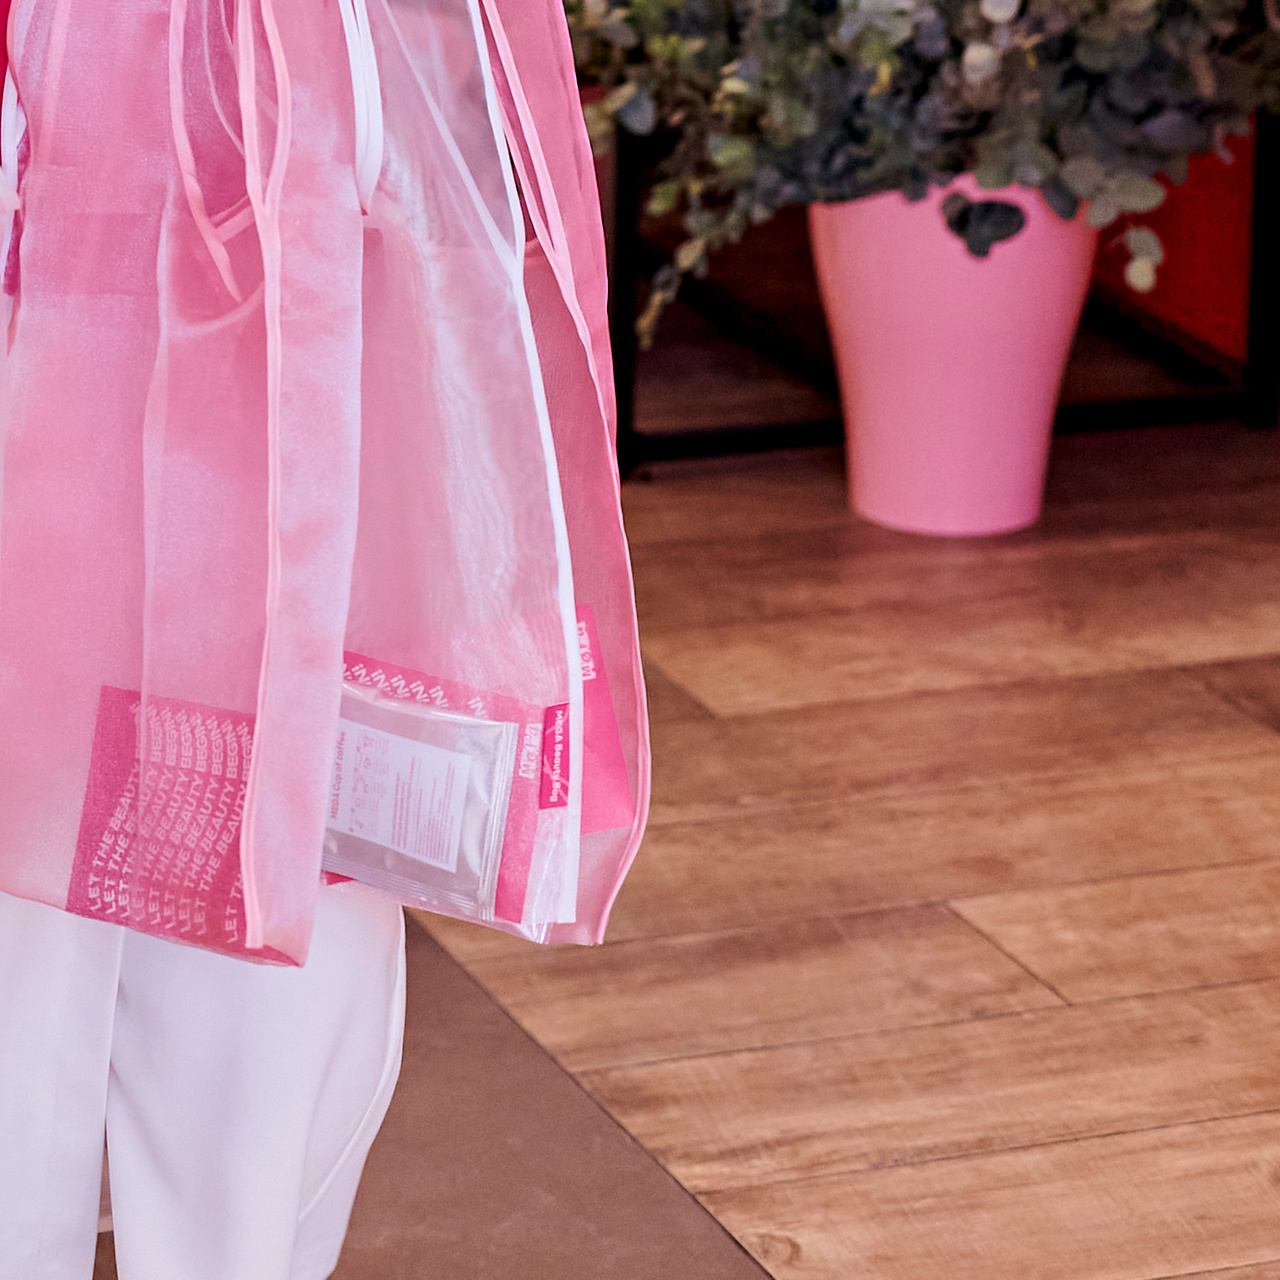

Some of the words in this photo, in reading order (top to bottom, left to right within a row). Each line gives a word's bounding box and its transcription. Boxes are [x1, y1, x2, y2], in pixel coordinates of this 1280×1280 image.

[205, 715, 223, 776] BEGIN!
[555, 710, 564, 742] MEGA
[220, 719, 239, 780] BEGIN!
[336, 731, 346, 761] coffee
[551, 743, 564, 781] Beauty
[332, 773, 343, 791] Cup
[549, 781, 561, 803] Bag
[154, 770, 189, 841] BEAUTY
[169, 773, 203, 845] BEAUTY
[185, 777, 219, 849] BEAUTY
[200, 780, 235, 853] BEAUTY
[330, 792, 340, 819] MEGA
[92, 831, 115, 868] THE
[107, 833, 131, 871] THE
[152, 843, 175, 882] THE
[168, 847, 191, 886] THE
[183, 852, 206, 889] THE
[198, 855, 221, 892] THE
[88, 873, 102, 911] LET
[103, 876, 117, 915] LET
[118, 879, 131, 918] LET
[148, 887, 161, 925] LET
[163, 890, 176, 929] LET
[179, 894, 192, 933] LET
[194, 897, 207, 936] LET
[225, 904, 239, 943] LET
